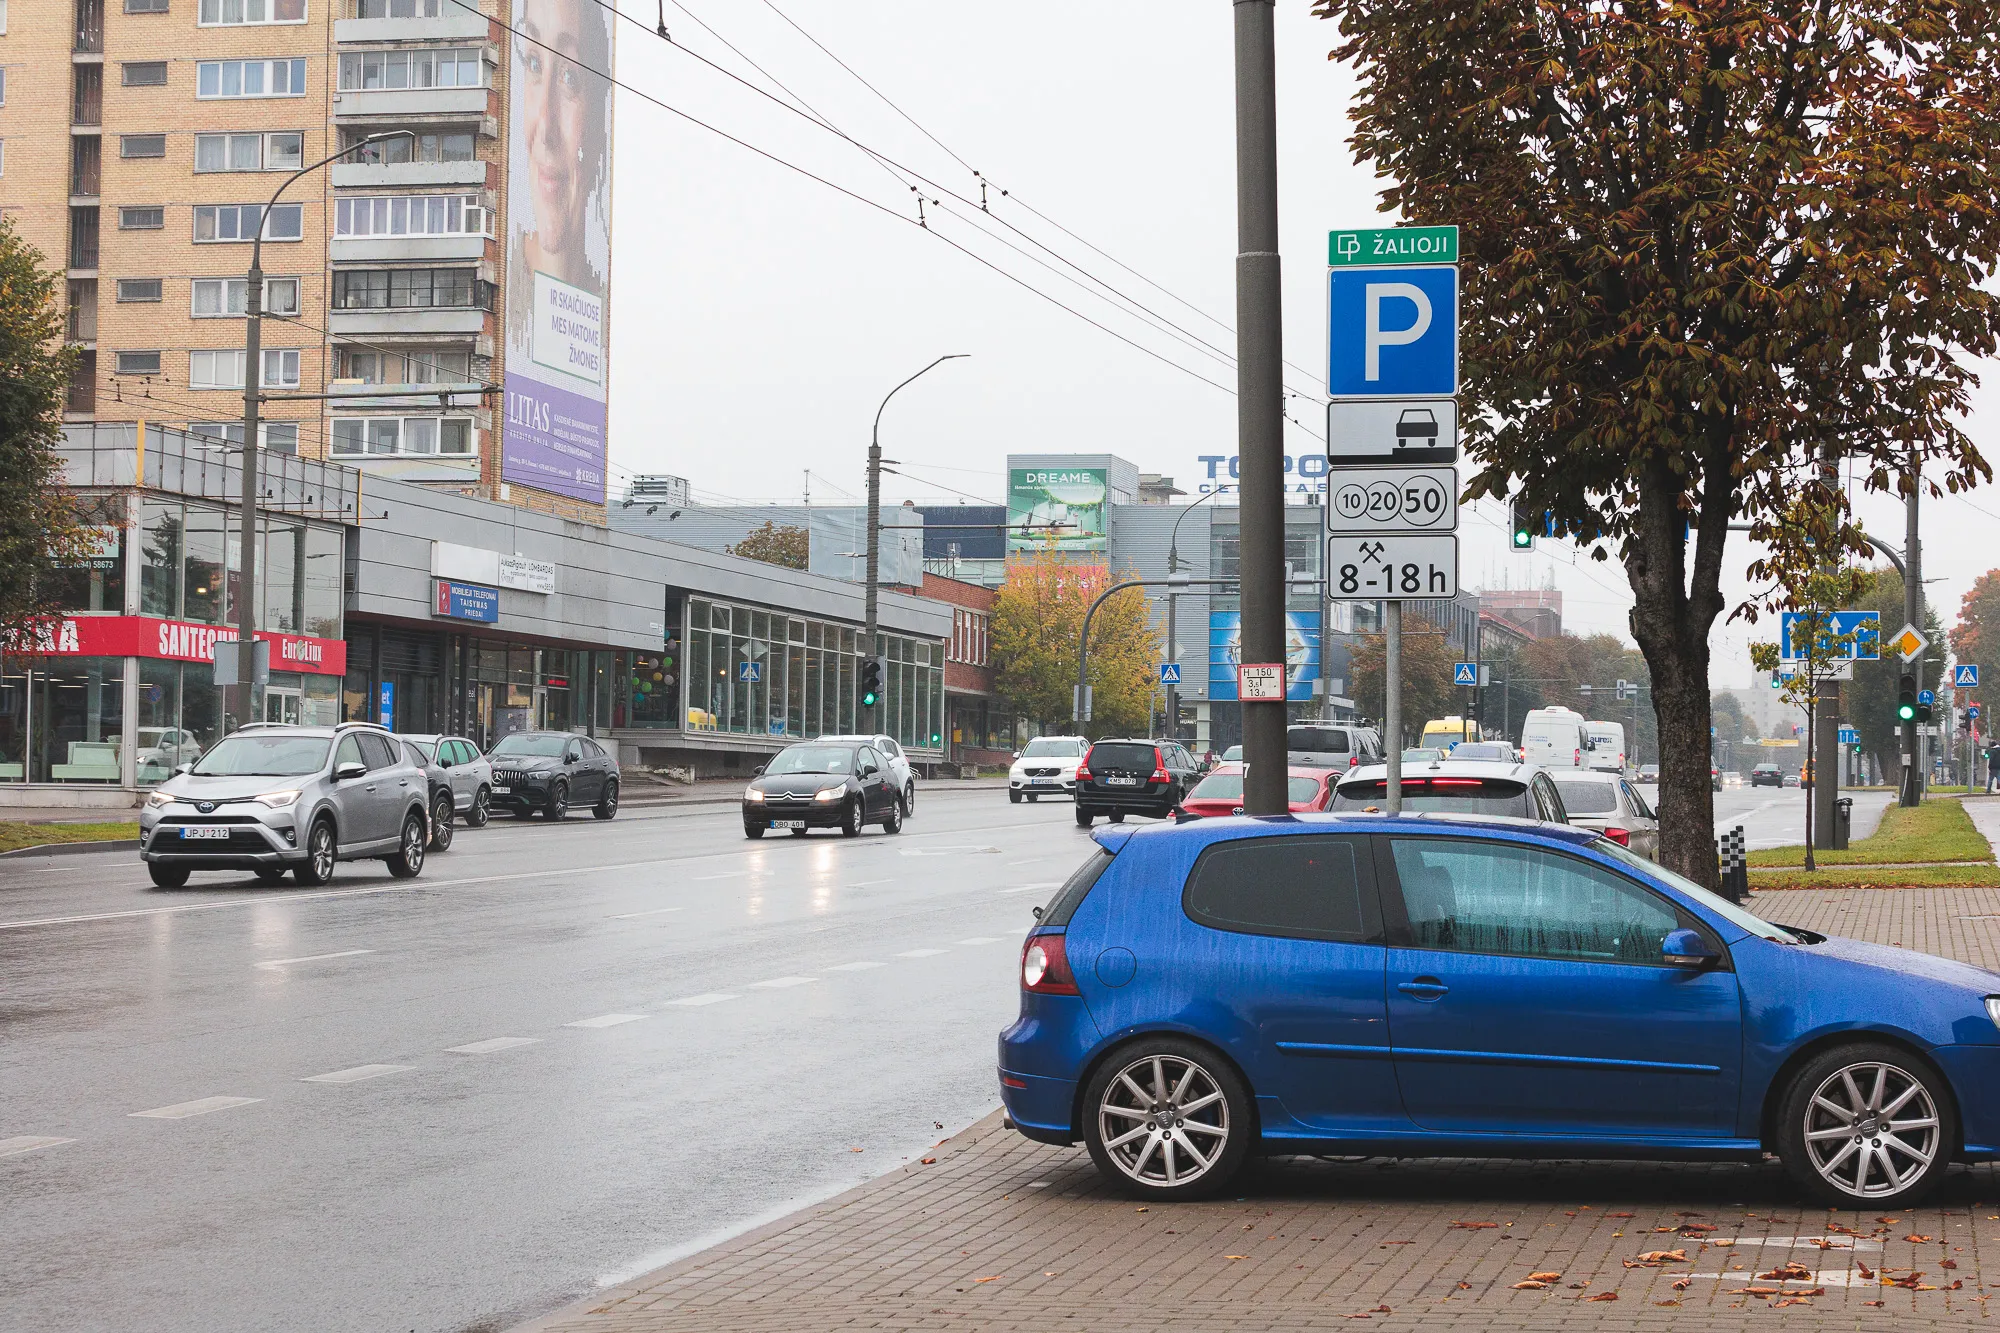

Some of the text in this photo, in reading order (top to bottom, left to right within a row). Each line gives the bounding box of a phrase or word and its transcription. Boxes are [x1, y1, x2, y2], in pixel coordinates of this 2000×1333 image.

[1373, 233, 1447, 255] ŽALIOJI
[550, 288, 600, 322] IR SKAIČIUOSE
[551, 314, 599, 347] MES MATOME
[1365, 282, 1433, 382] P
[568, 343, 598, 371] ŽMONES
[509, 391, 550, 433] LITAS
[1198, 455, 1329, 478] TO
[581, 469, 600, 484] KREDA
[1026, 472, 1091, 483] DREAME
[1199, 483, 1328, 493] CEAS
[1342, 487, 1441, 513] 10 20 50
[93, 560, 114, 569] 58673
[528, 562, 554, 575] LOMBARDAS
[1339, 563, 1446, 594] 8-18 h
[451, 586, 497, 600] MOBILIEJI TELEFONAI
[460, 598, 488, 610] TAISYMAS
[464, 609, 484, 618] PRIEDAI
[1243, 668, 1250, 676] H
[1256, 667, 1272, 676] 150
[1243, 762, 1251, 779] 7
[186, 829, 228, 838] JPJ 212
